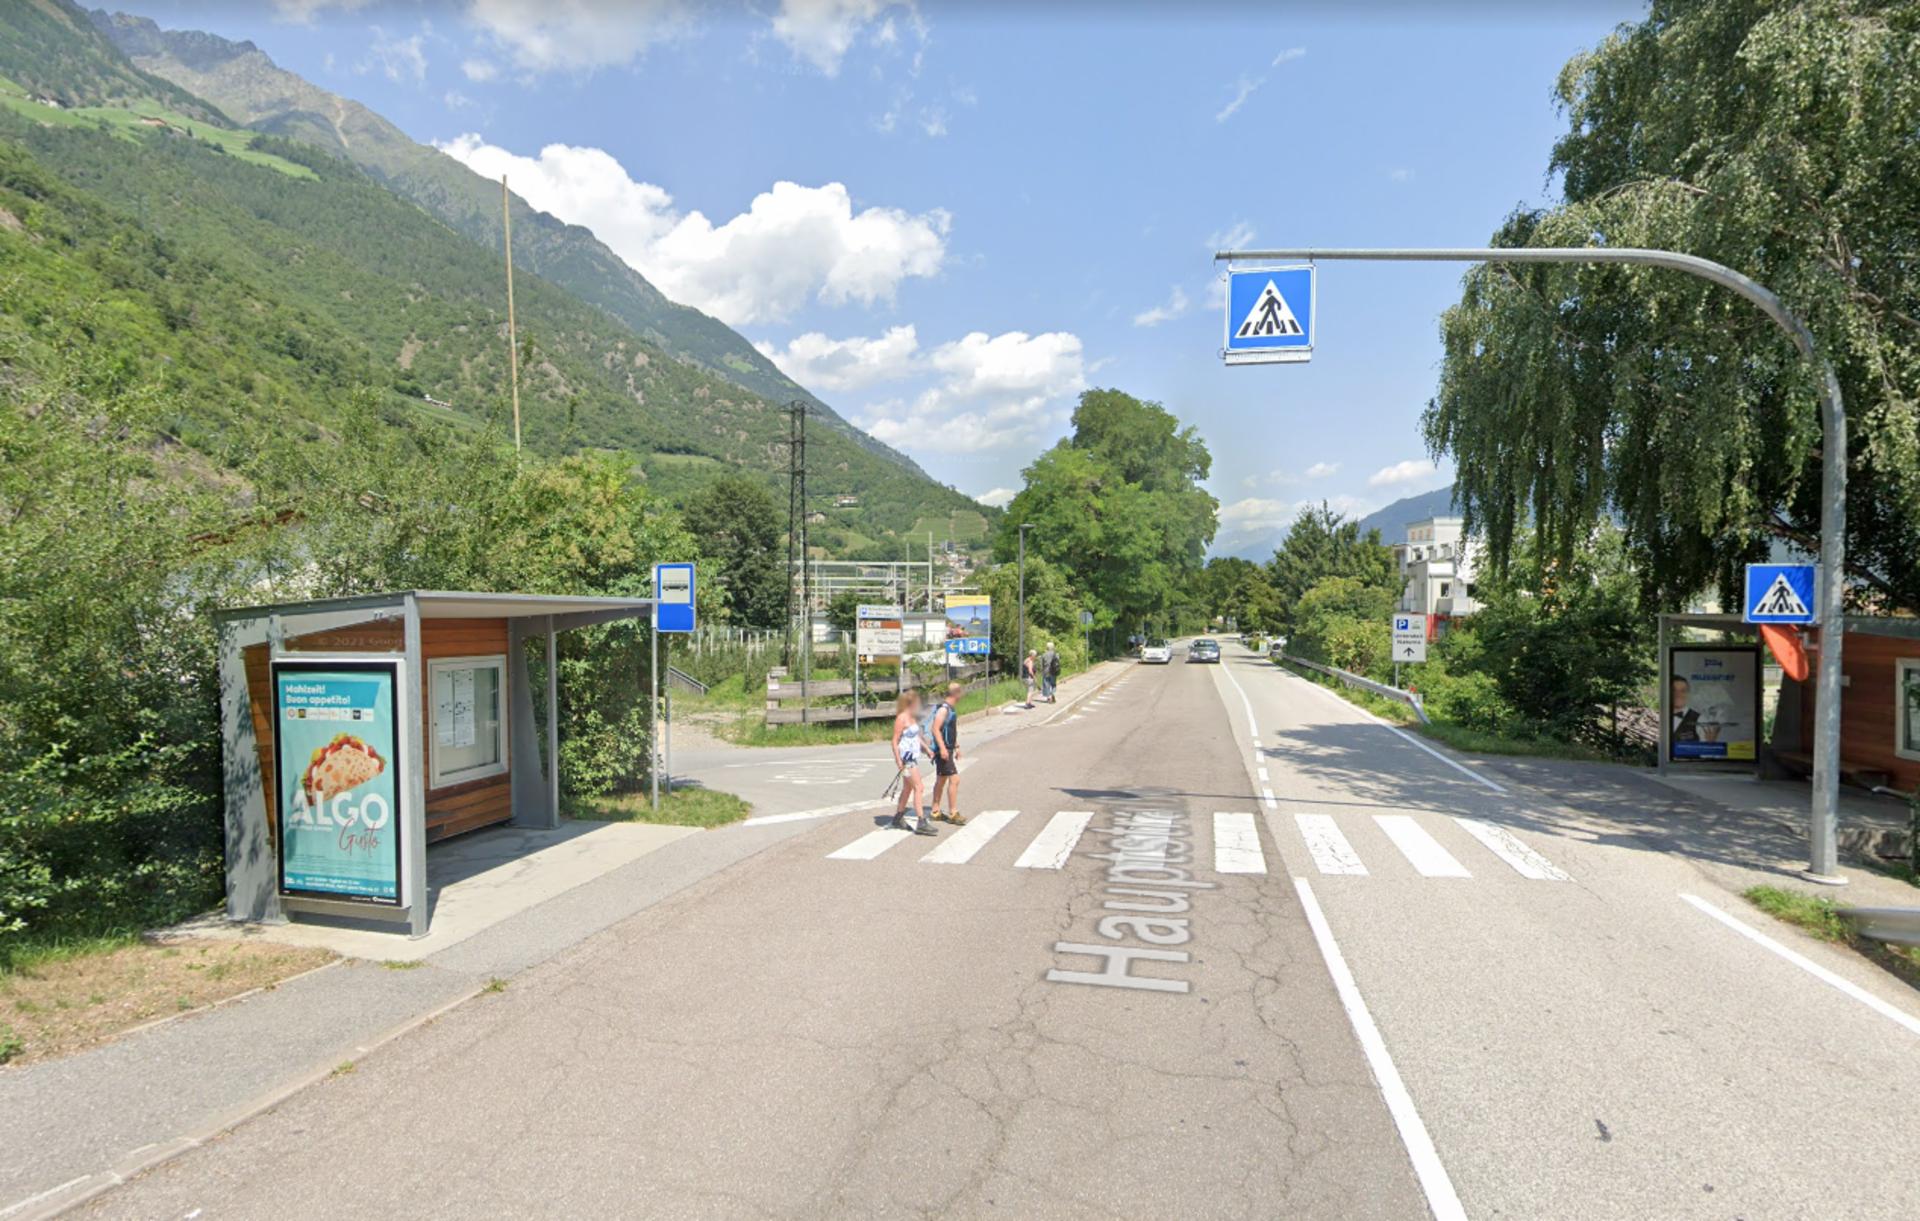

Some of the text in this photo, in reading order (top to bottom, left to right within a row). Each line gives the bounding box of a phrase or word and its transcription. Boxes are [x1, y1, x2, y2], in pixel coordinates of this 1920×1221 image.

[285, 684, 326, 694] Mahlzeit!
[286, 695, 351, 706] Buon appetito!
[288, 789, 389, 830] ALGO
[338, 817, 385, 857] Gusto
